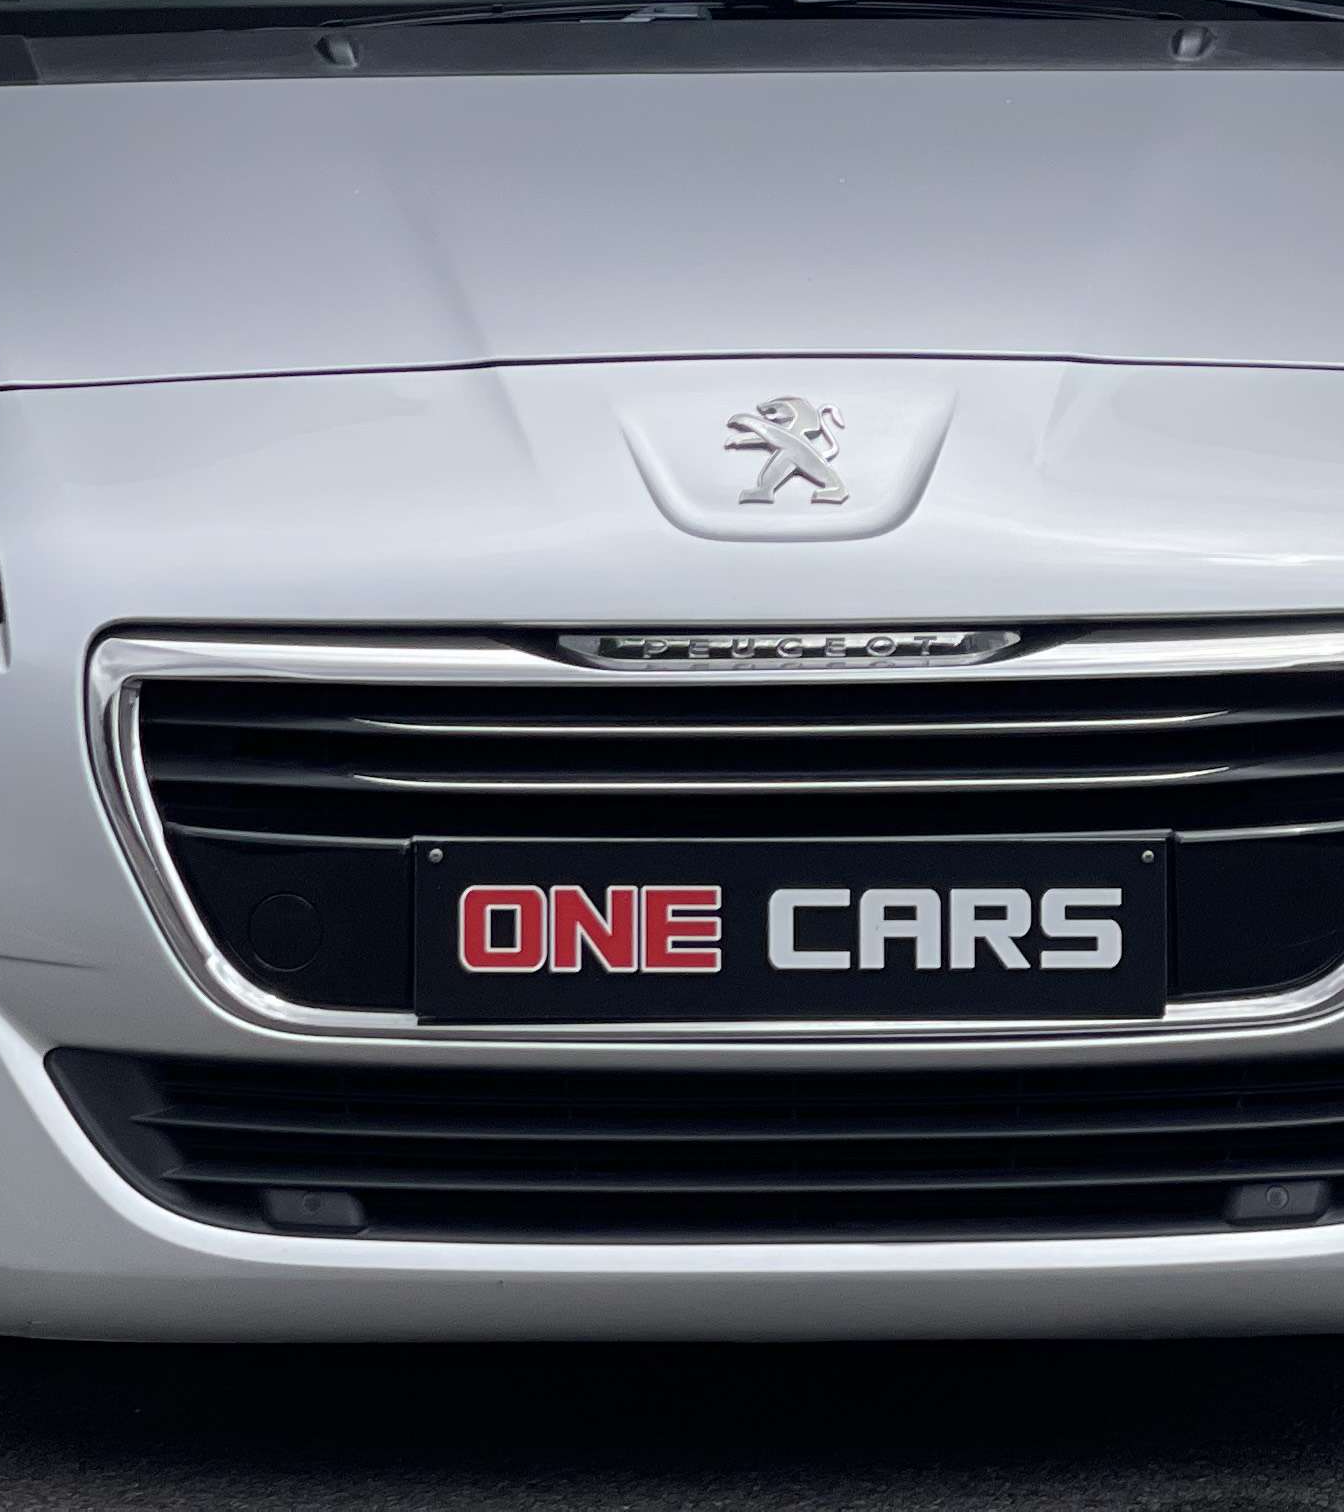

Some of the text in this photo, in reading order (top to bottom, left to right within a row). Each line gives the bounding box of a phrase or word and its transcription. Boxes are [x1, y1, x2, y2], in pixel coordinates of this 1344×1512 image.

[642, 634, 938, 659] PEUGEOT
[458, 884, 1123, 974] ONE CARS
